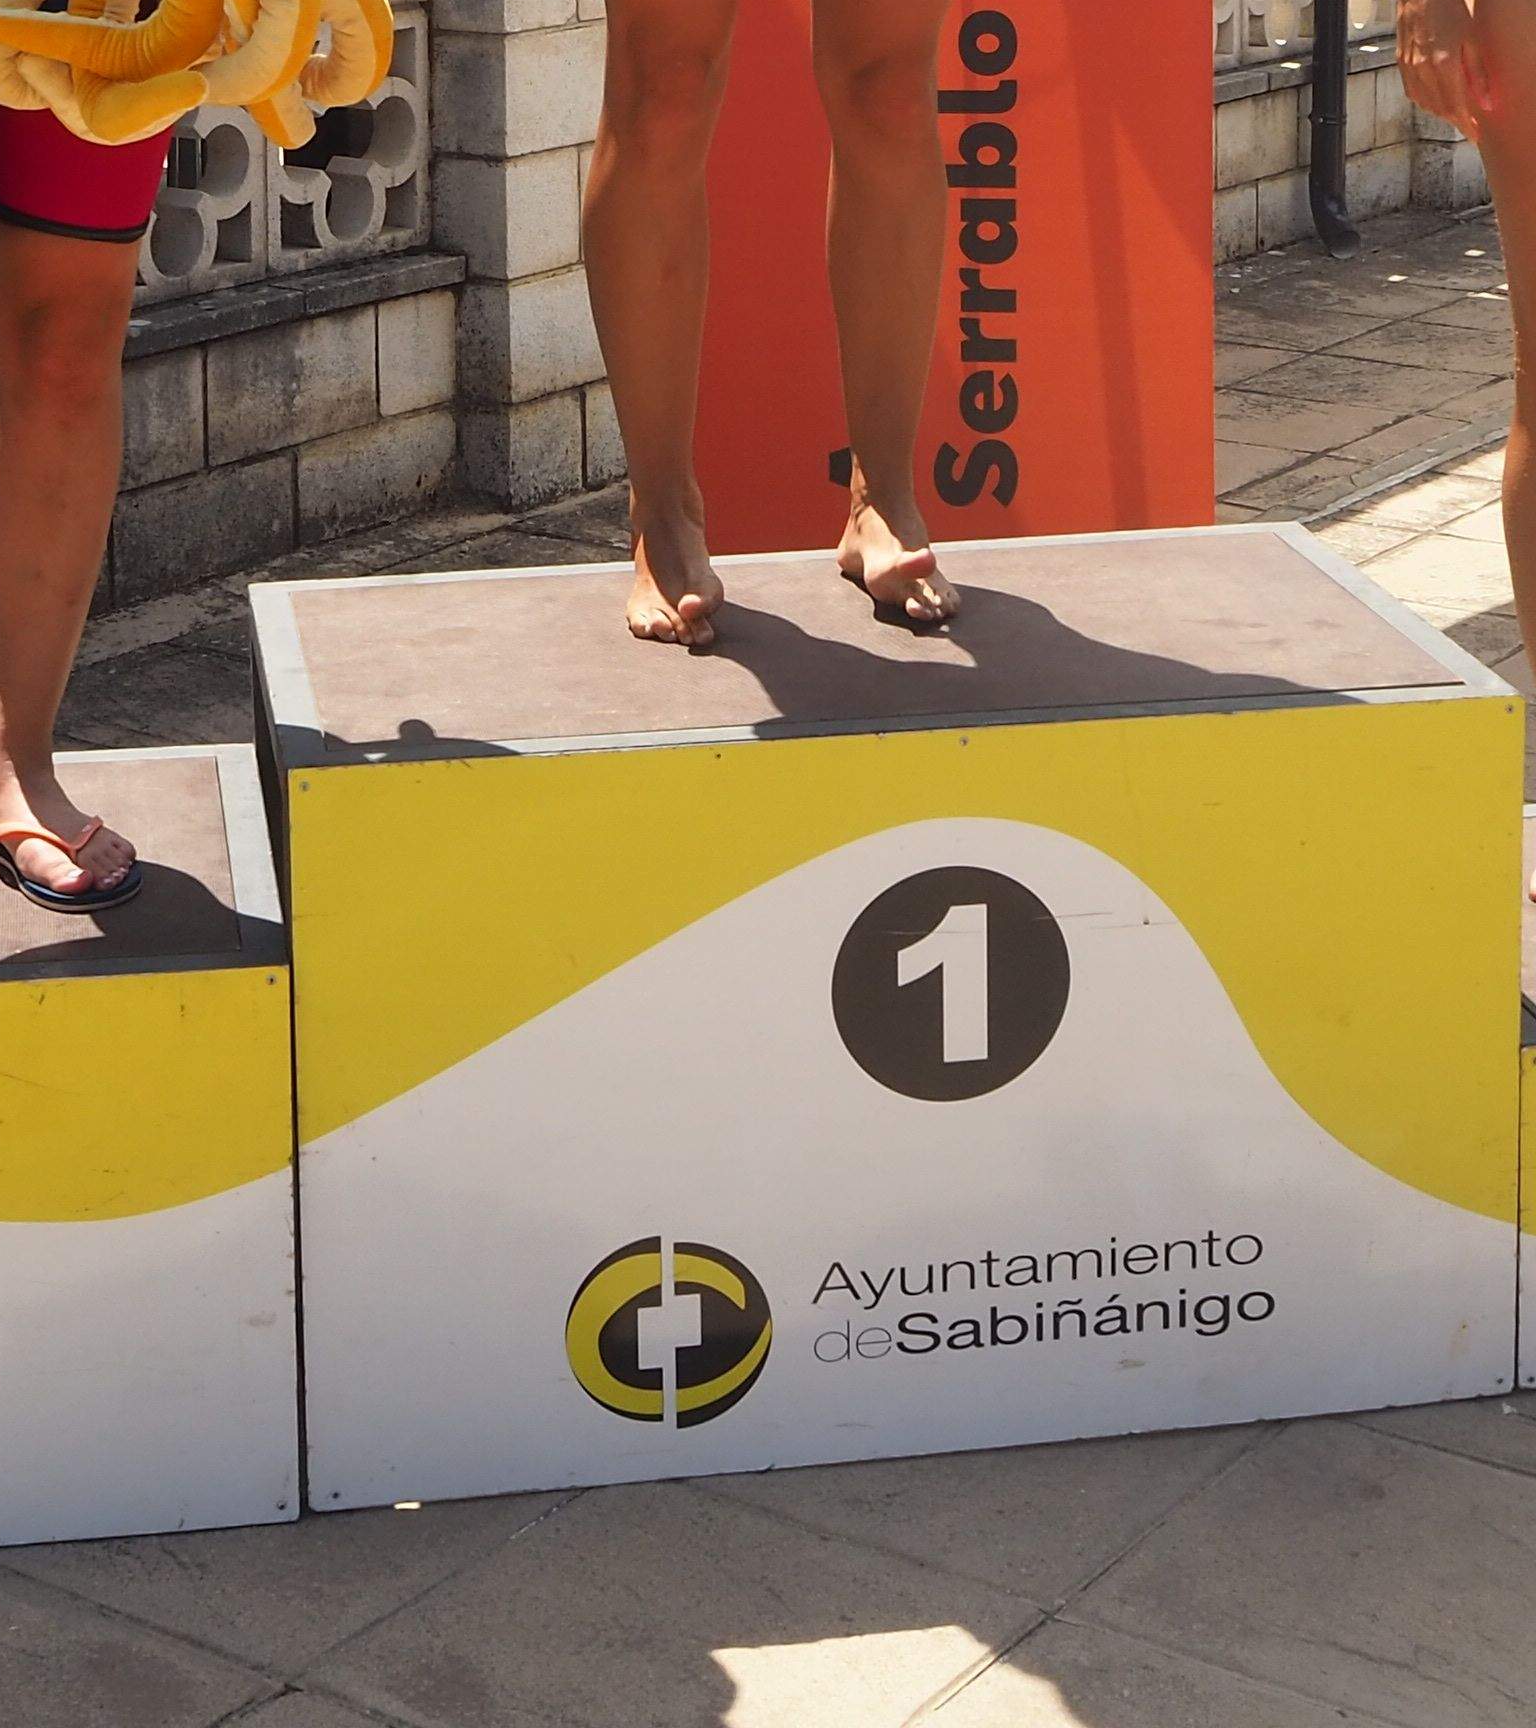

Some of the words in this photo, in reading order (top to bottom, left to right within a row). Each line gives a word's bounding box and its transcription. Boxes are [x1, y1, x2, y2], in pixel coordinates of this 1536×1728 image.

[933, 9, 1019, 509] Serrablo
[896, 903, 989, 1064] 1
[811, 1229, 1264, 1310] Ayuntamiento
[812, 1287, 1276, 1363] deSabiñánigo
